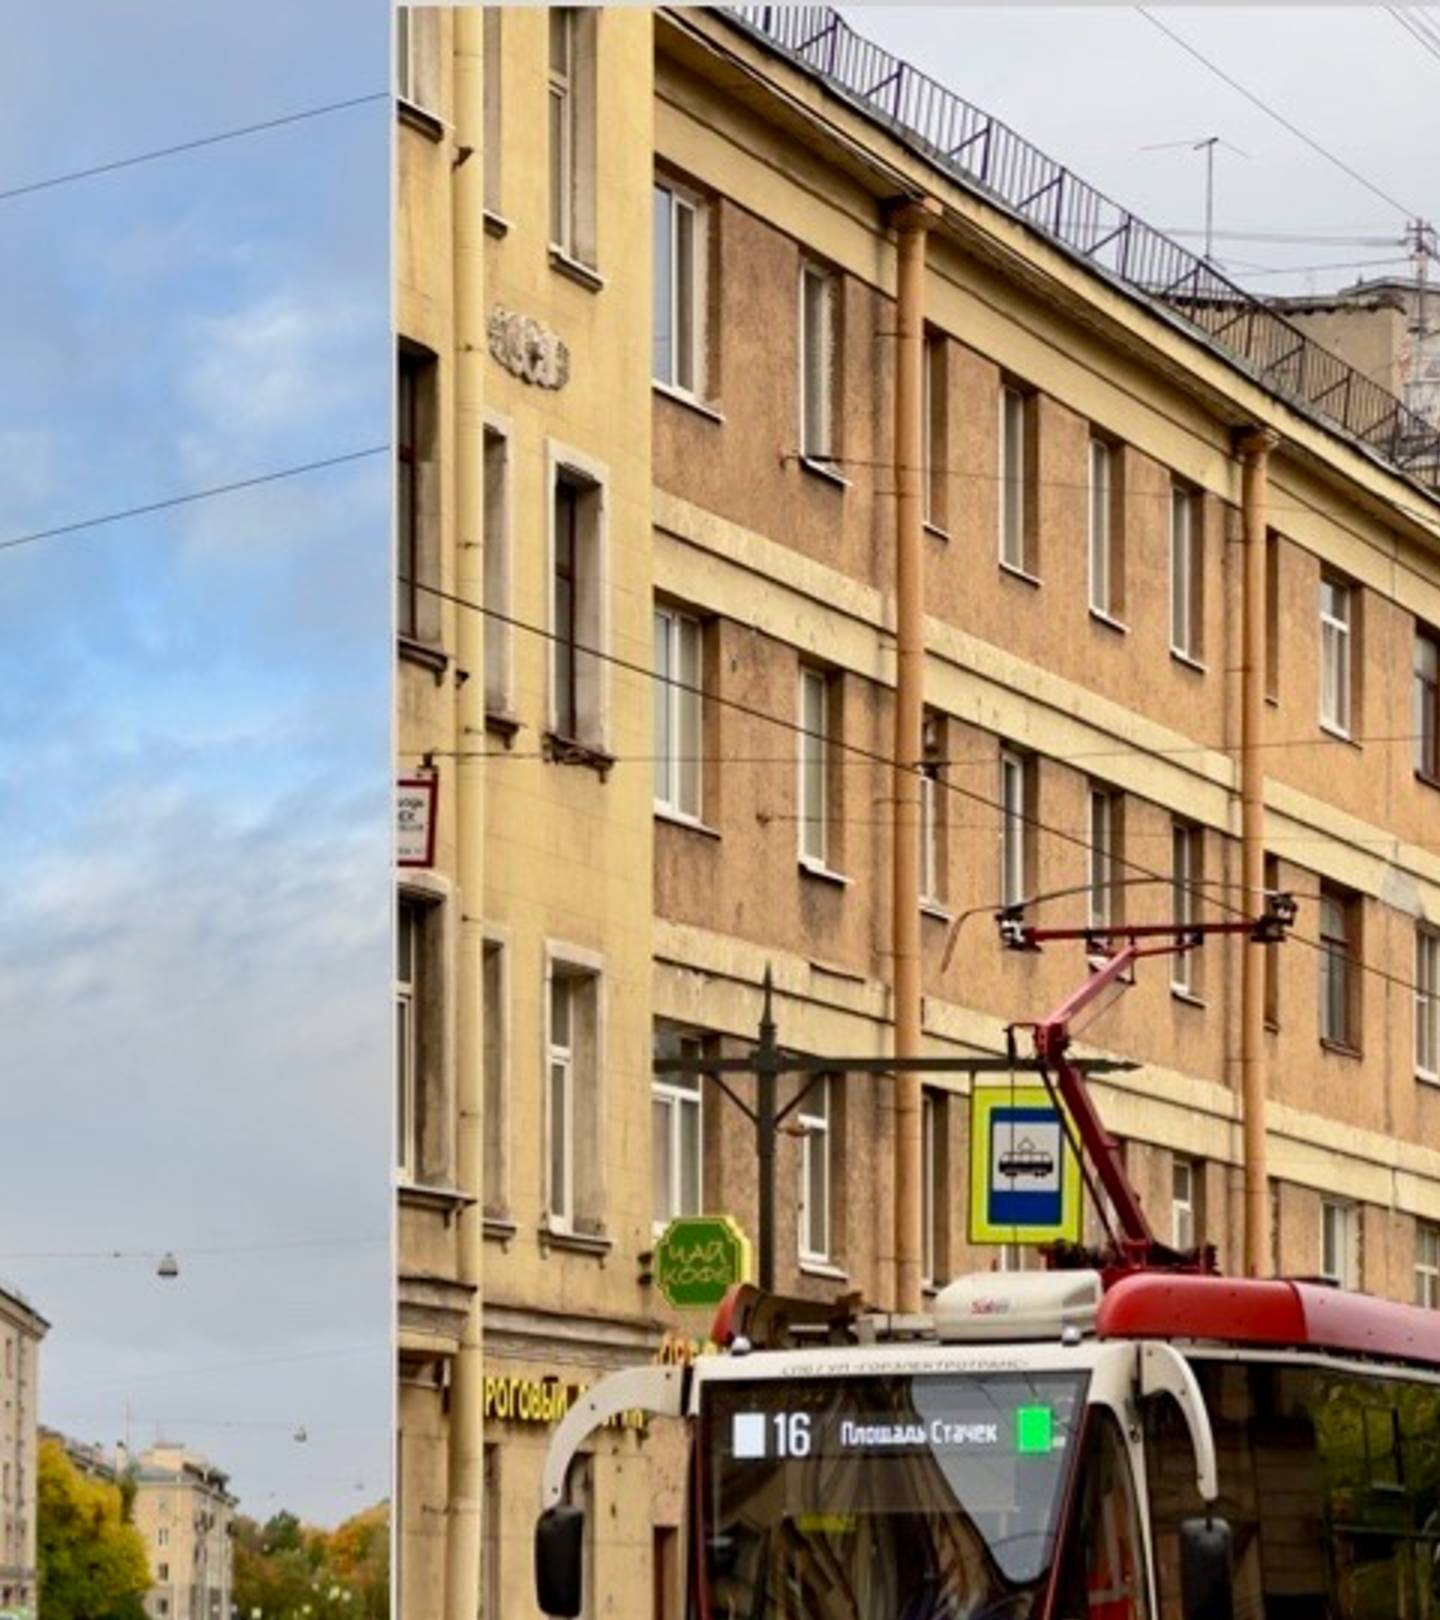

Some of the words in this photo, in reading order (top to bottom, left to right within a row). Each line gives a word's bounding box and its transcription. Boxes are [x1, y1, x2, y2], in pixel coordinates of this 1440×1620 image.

[669, 1241, 728, 1264] ЧАЙ
[773, 1412, 811, 1457] 16
[840, 1420, 927, 1446] Площадь
[930, 1418, 997, 1444] Стачек
